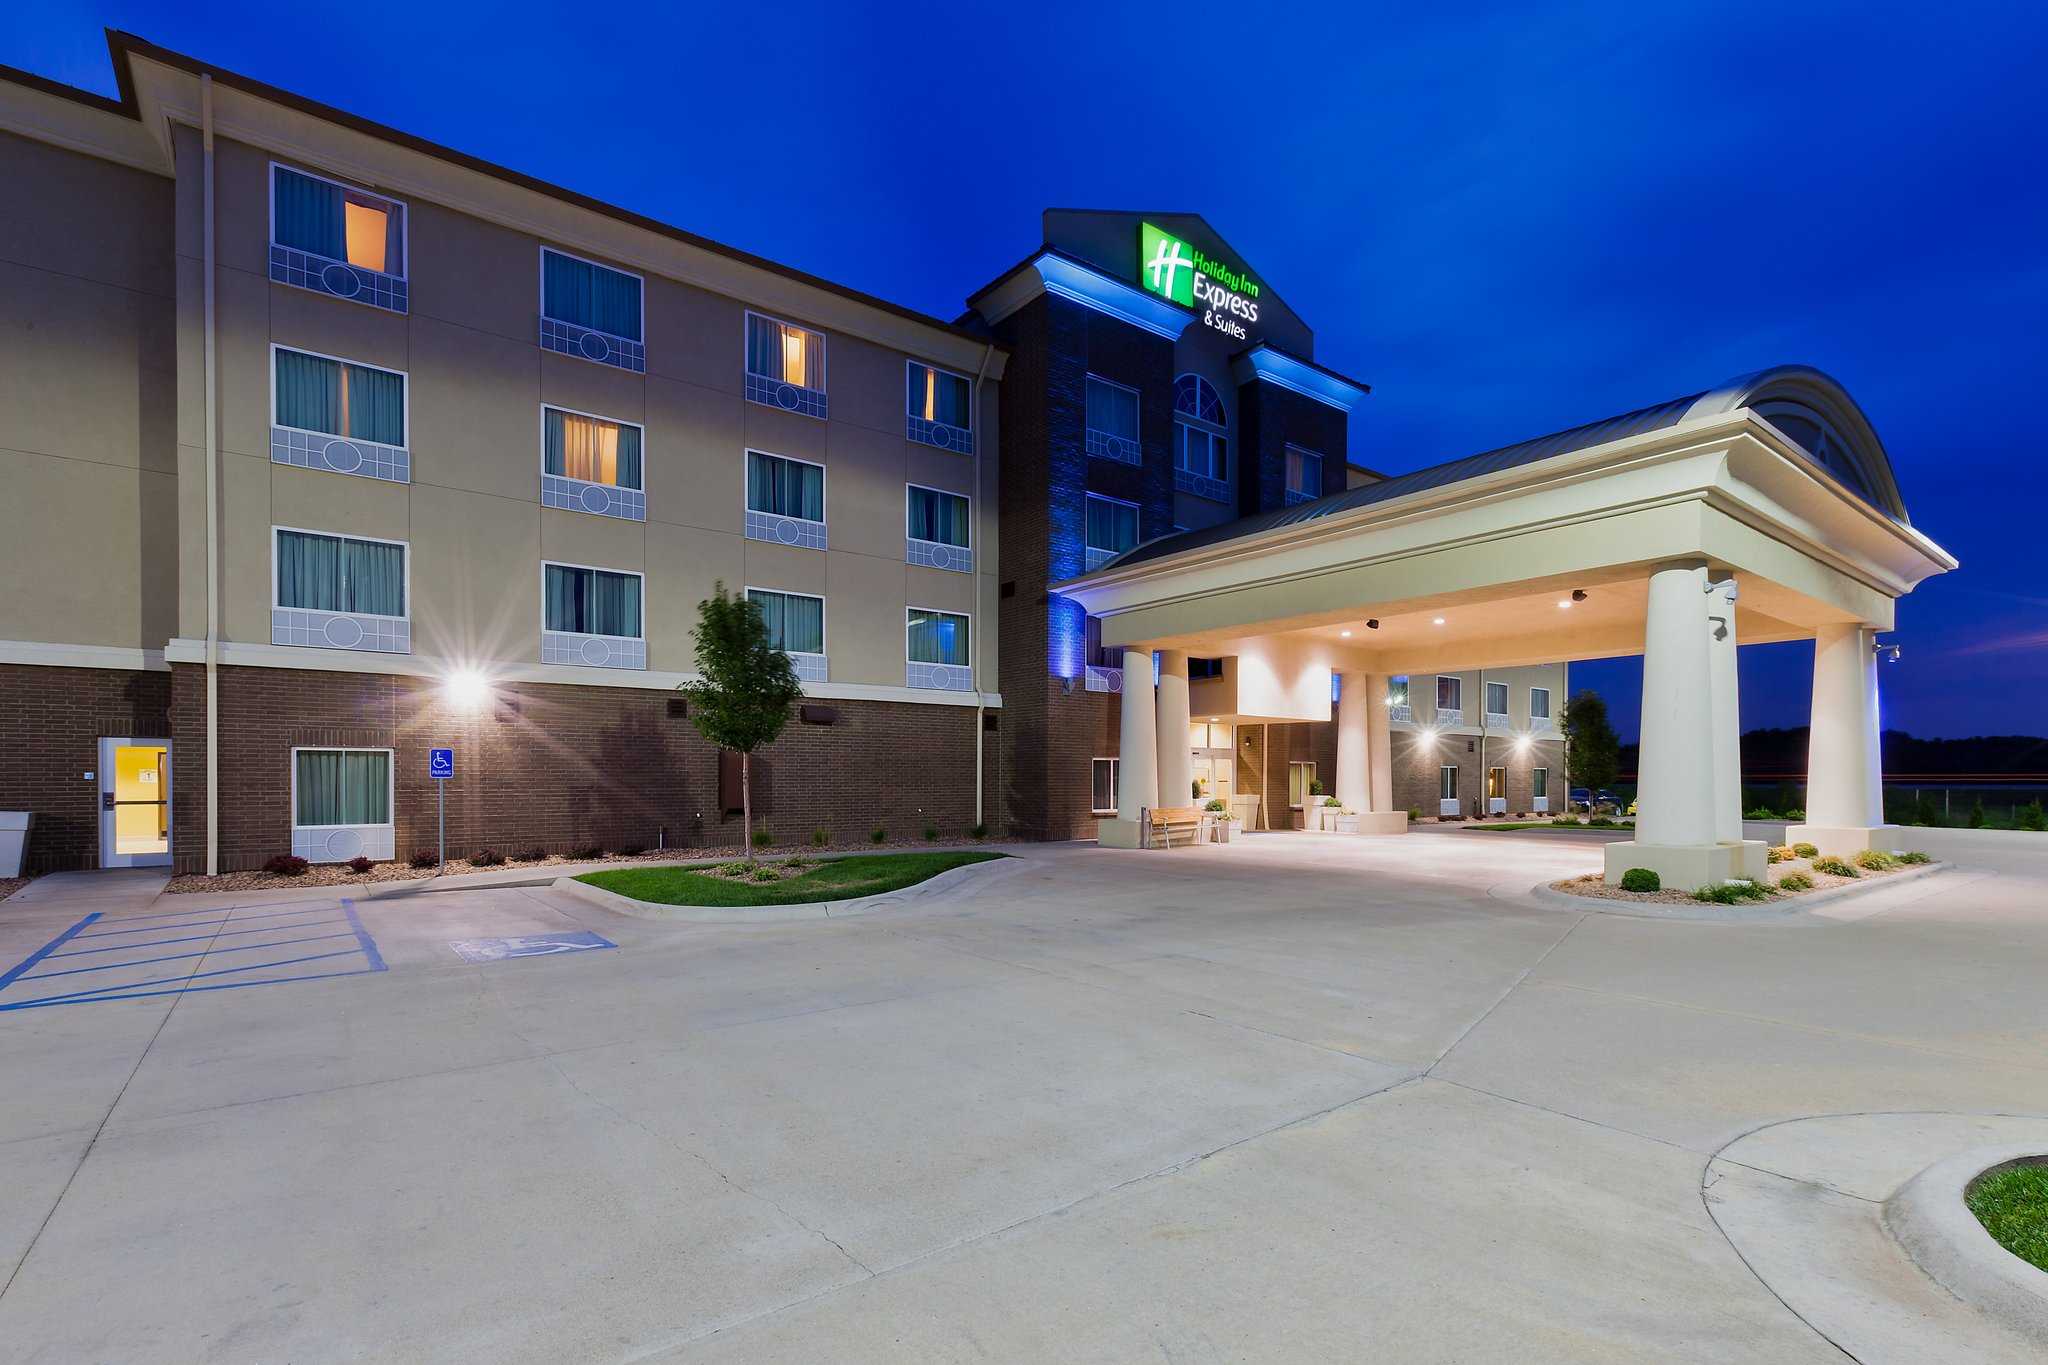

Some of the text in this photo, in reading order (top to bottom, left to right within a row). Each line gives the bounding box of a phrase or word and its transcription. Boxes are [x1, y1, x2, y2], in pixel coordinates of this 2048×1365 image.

[1193, 251, 1258, 297] Holiday Inn
[1193, 272, 1258, 322] Express
[1204, 310, 1246, 340] & Suites
